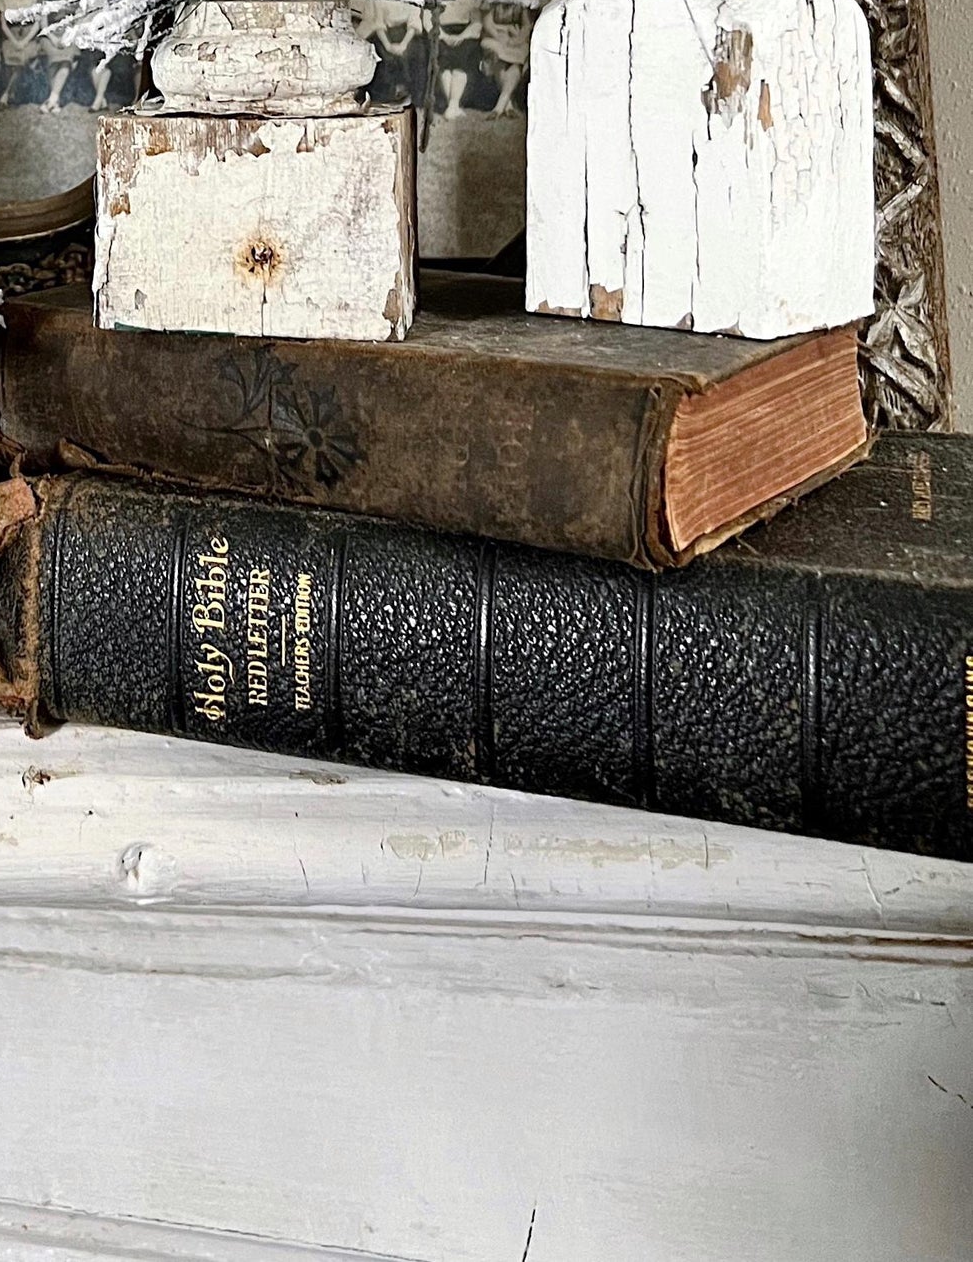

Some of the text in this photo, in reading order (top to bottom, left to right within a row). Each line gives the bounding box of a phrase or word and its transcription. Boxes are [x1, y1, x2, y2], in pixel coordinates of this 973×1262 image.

[192, 537, 235, 721] Holy Bible
[246, 568, 271, 706] RED LETTER
[294, 573, 313, 632] EDITION
